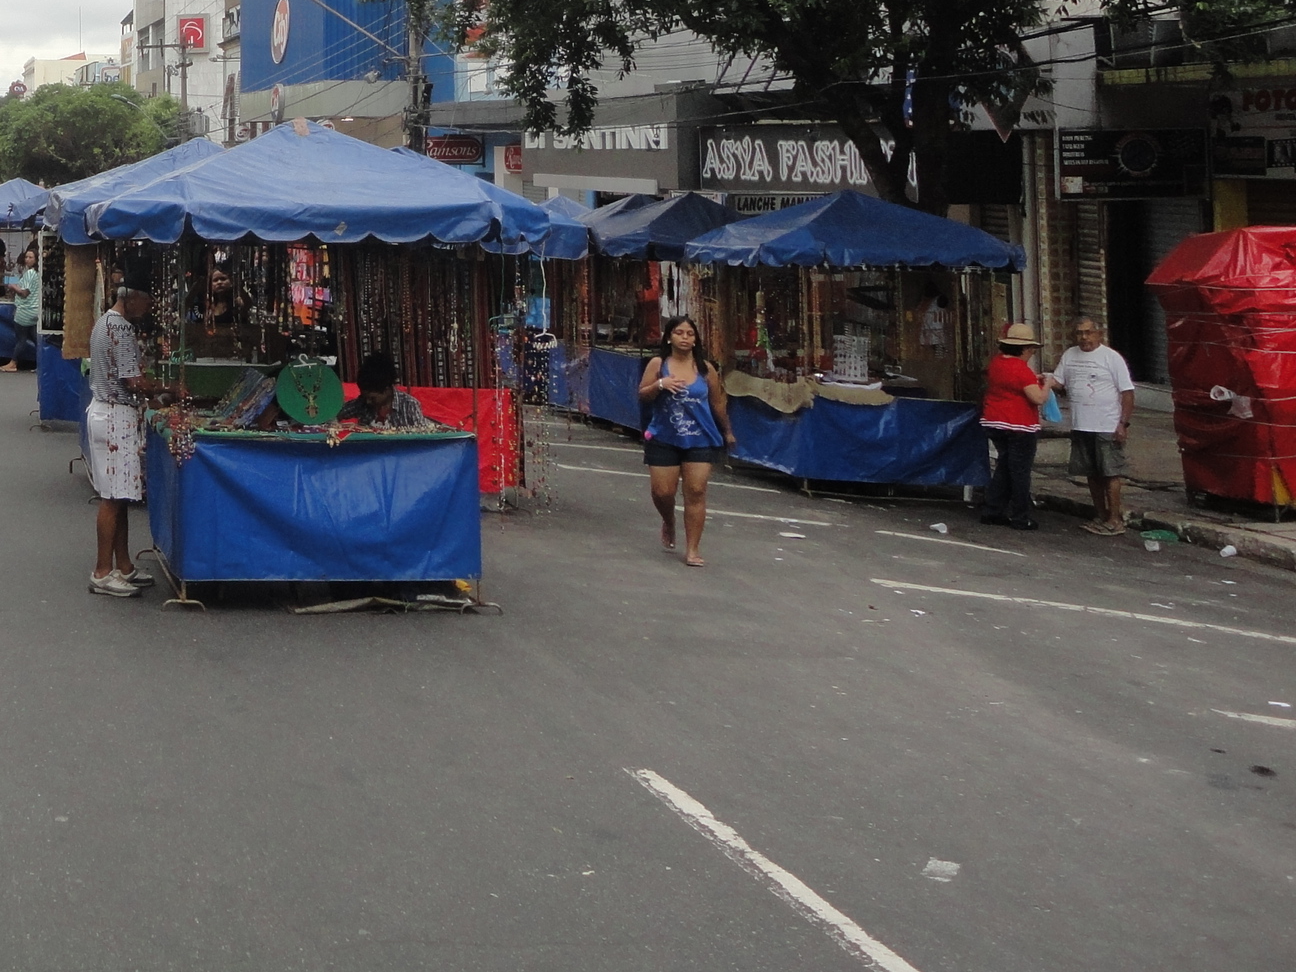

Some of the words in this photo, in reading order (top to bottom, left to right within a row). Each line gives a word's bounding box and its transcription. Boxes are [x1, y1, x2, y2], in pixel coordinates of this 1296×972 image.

[524, 127, 546, 149] DI
[552, 123, 669, 150] SANTINNI
[702, 135, 773, 183] ASYA
[737, 196, 776, 211] LANCHE
